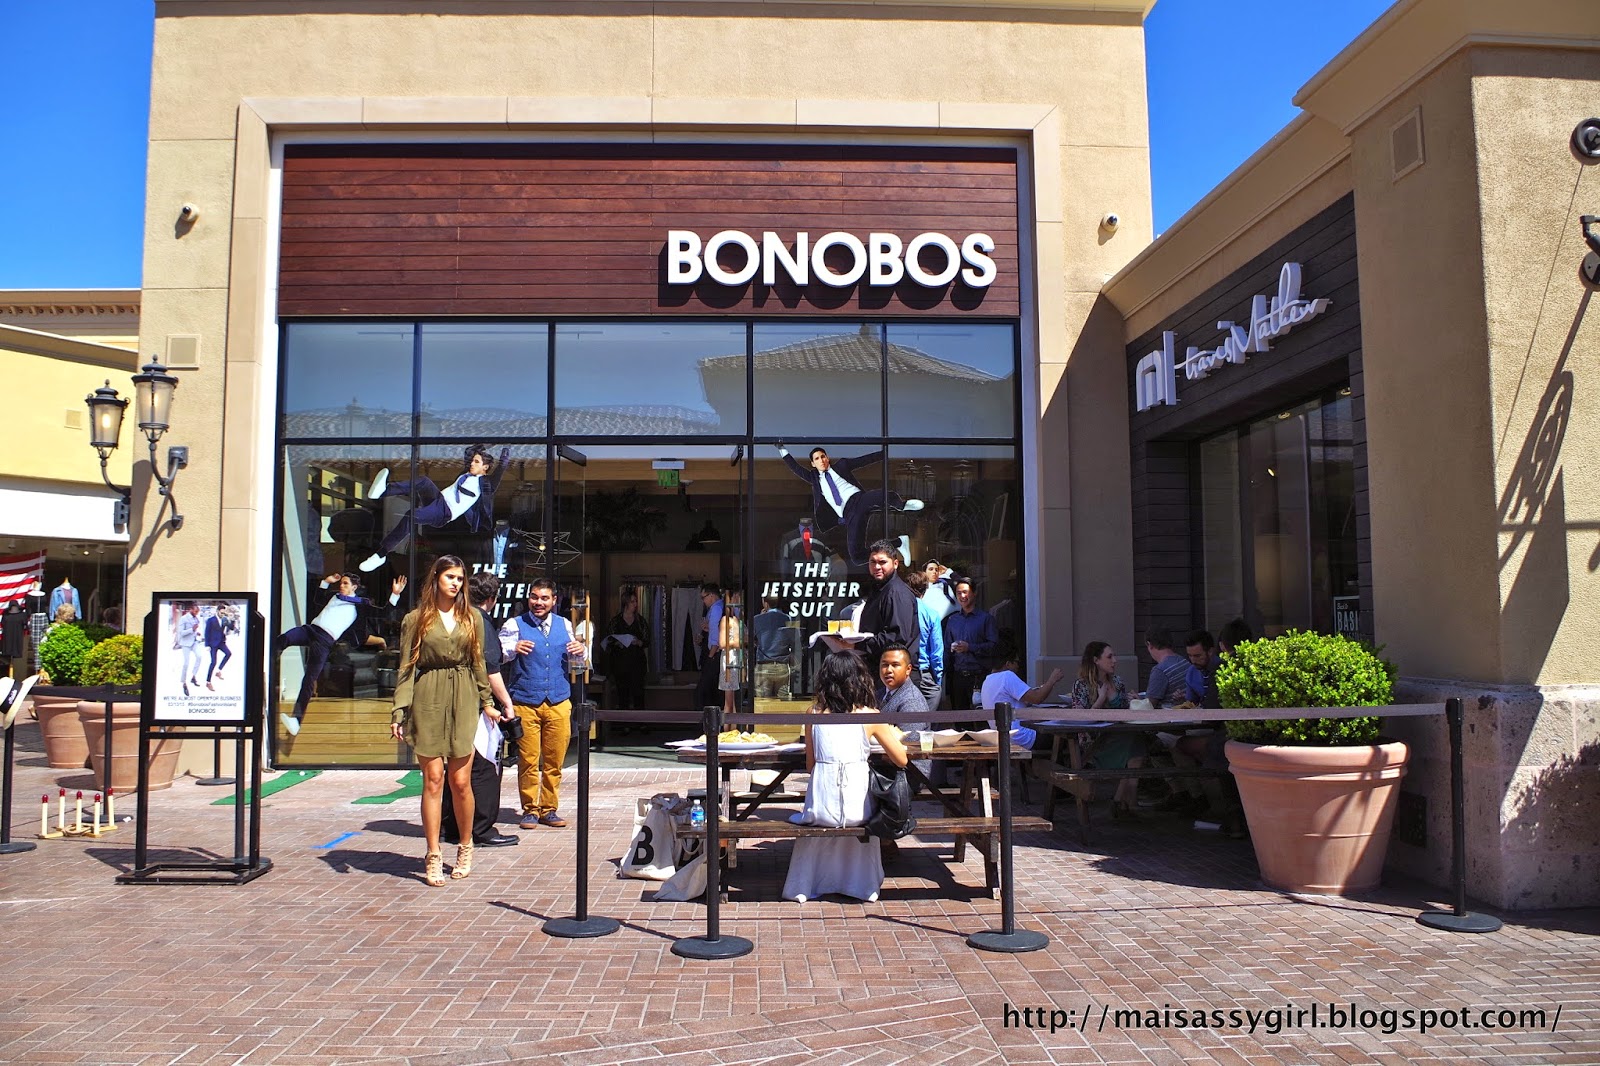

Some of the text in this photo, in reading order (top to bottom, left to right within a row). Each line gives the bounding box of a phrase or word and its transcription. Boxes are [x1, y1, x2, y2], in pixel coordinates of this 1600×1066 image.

[668, 230, 997, 287] BONOBOS
[473, 563, 507, 579] THE
[794, 562, 830, 578] THE
[761, 582, 861, 598] JETSETTER
[493, 603, 512, 619] IT
[789, 602, 835, 618] SUIT
[631, 825, 655, 866] B
